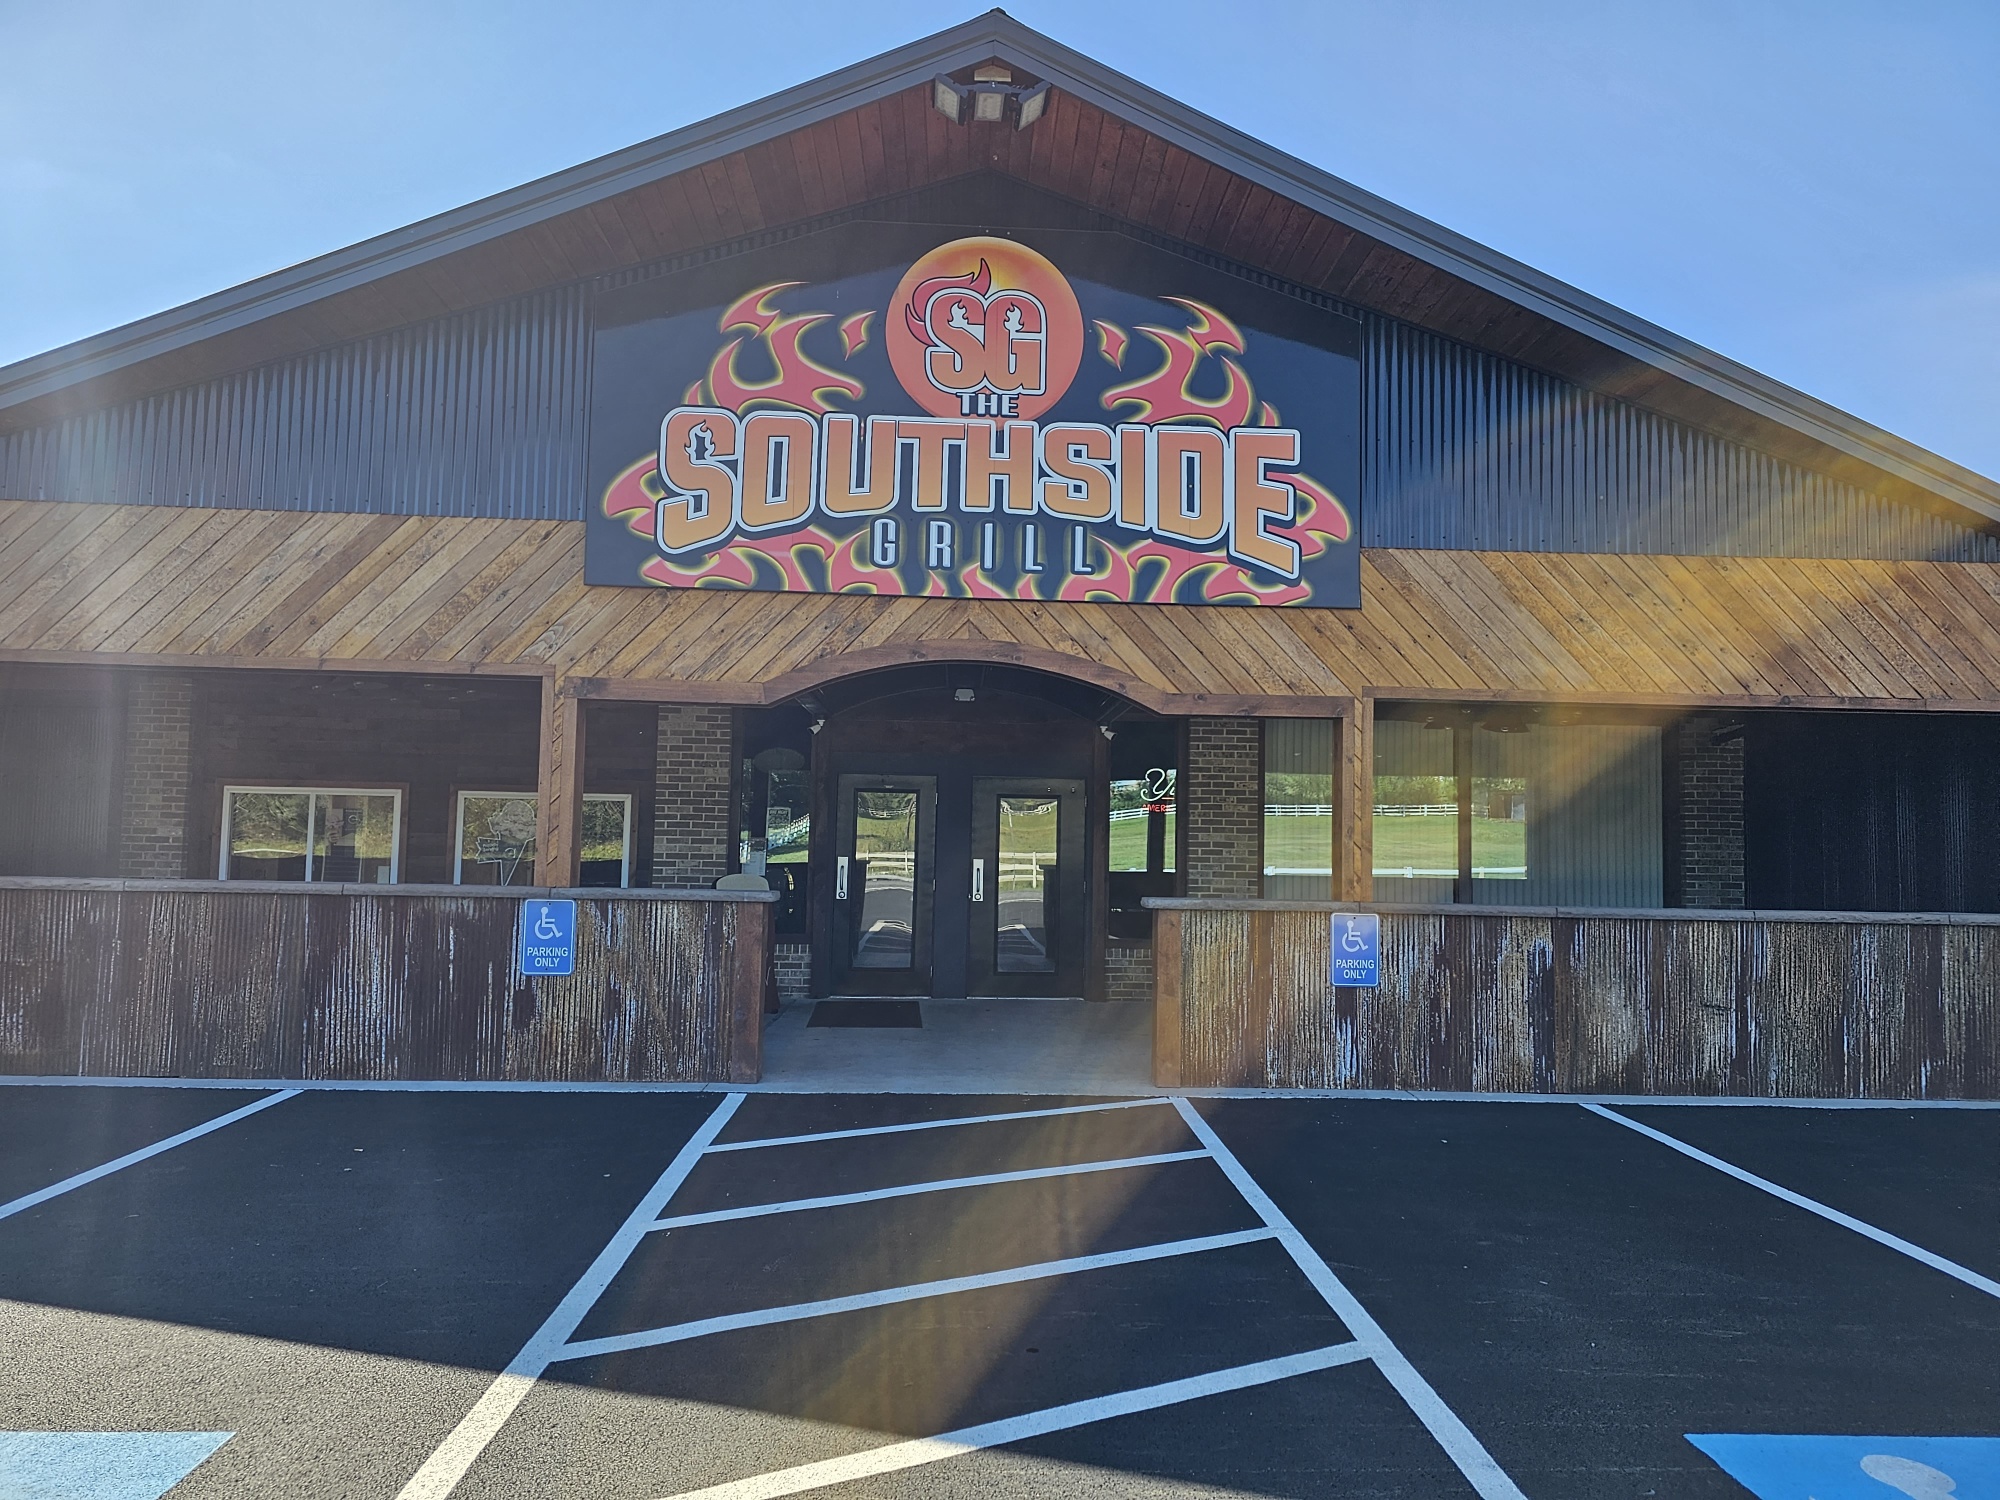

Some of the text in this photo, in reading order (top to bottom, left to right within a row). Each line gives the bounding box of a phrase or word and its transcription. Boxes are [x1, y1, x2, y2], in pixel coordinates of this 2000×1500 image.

[924, 287, 1047, 396] SG
[956, 392, 1019, 417] THE
[655, 406, 1302, 580] SOUTHSIDE
[872, 518, 1097, 574] GRILL
[527, 946, 569, 957] PARKING
[534, 957, 560, 967] ONLY
[1335, 959, 1375, 969] PARKING
[1343, 969, 1367, 979] ONLY
